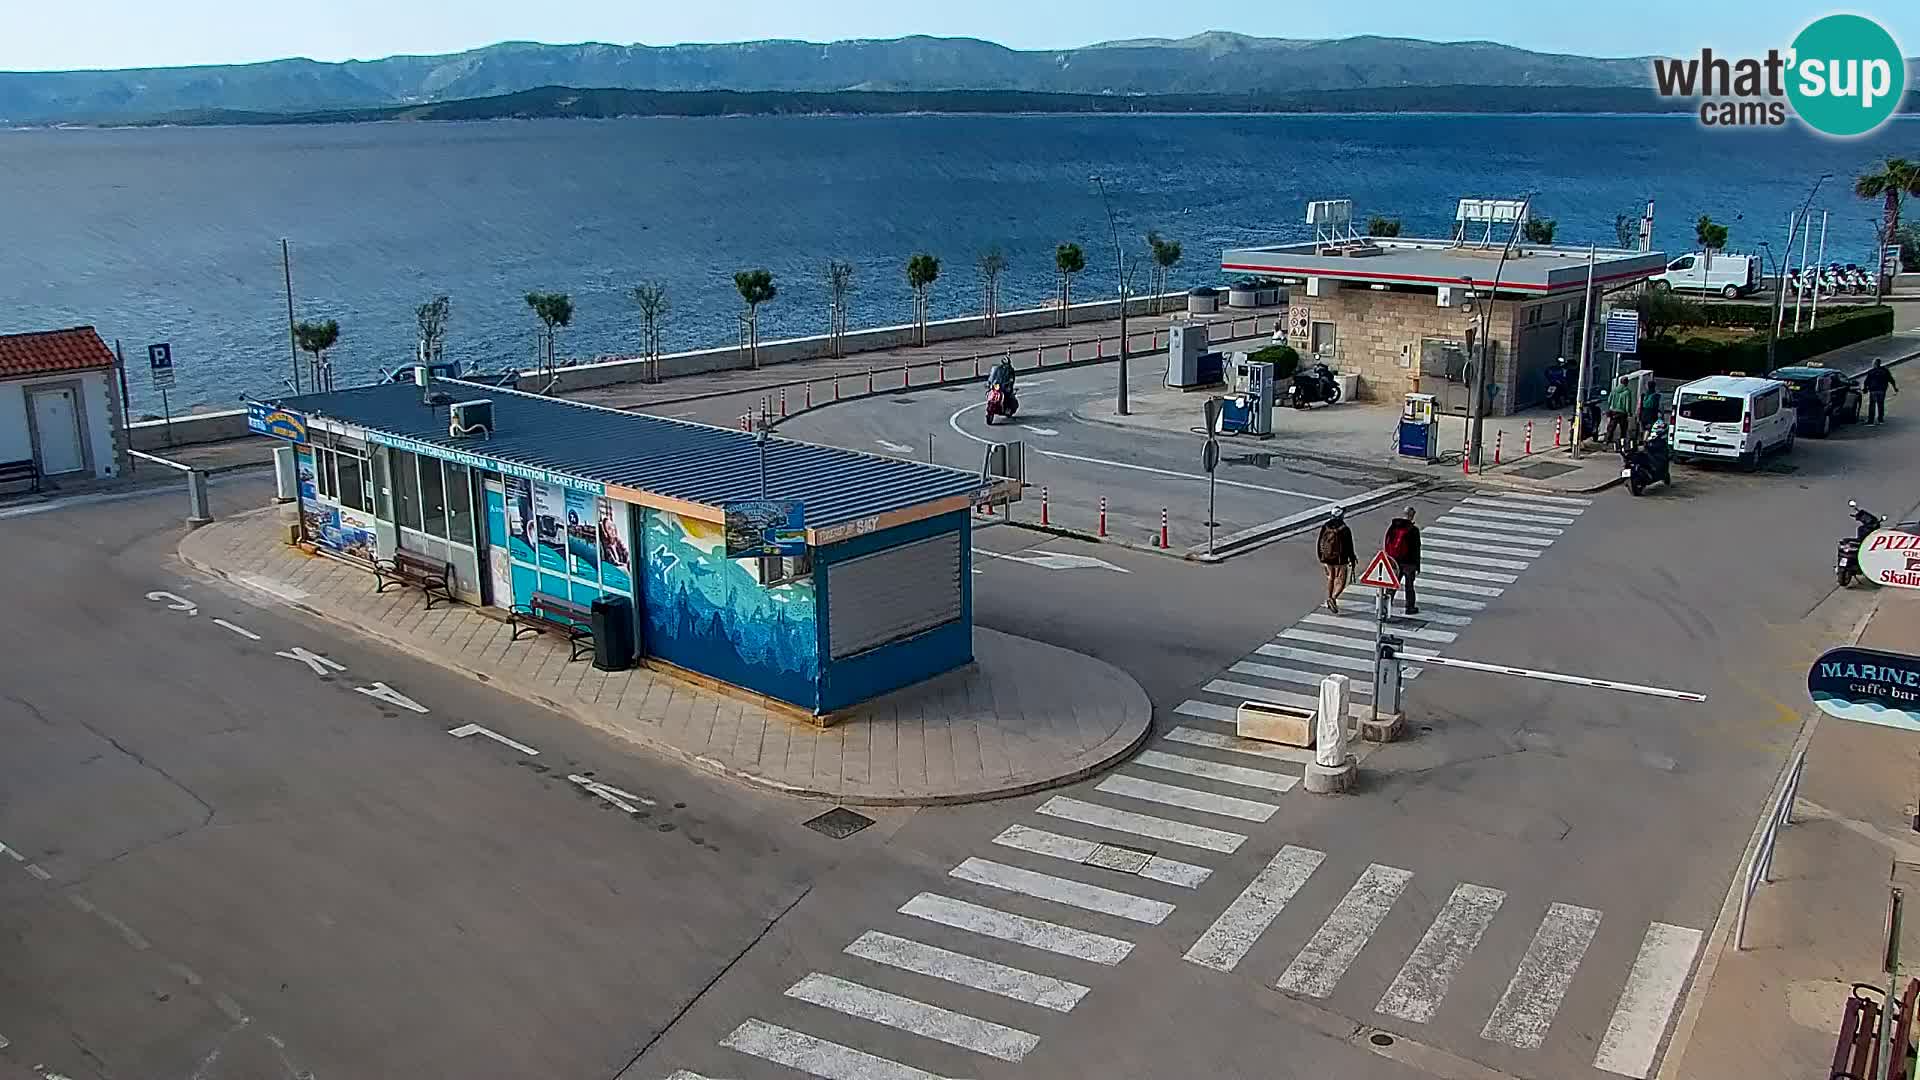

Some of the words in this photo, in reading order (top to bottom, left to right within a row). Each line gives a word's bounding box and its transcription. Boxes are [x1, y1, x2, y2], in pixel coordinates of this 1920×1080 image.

[154, 347, 165, 364] P
[458, 452, 489, 467] POSTAJA
[497, 463, 513, 475] BUS
[513, 467, 546, 481] STATION
[547, 473, 574, 488] TICKET
[575, 480, 601, 493] OFFICE
[1821, 662, 1920, 688] MARINE
[1850, 683, 1887, 696] caffe
[1891, 686, 1919, 701] bar
